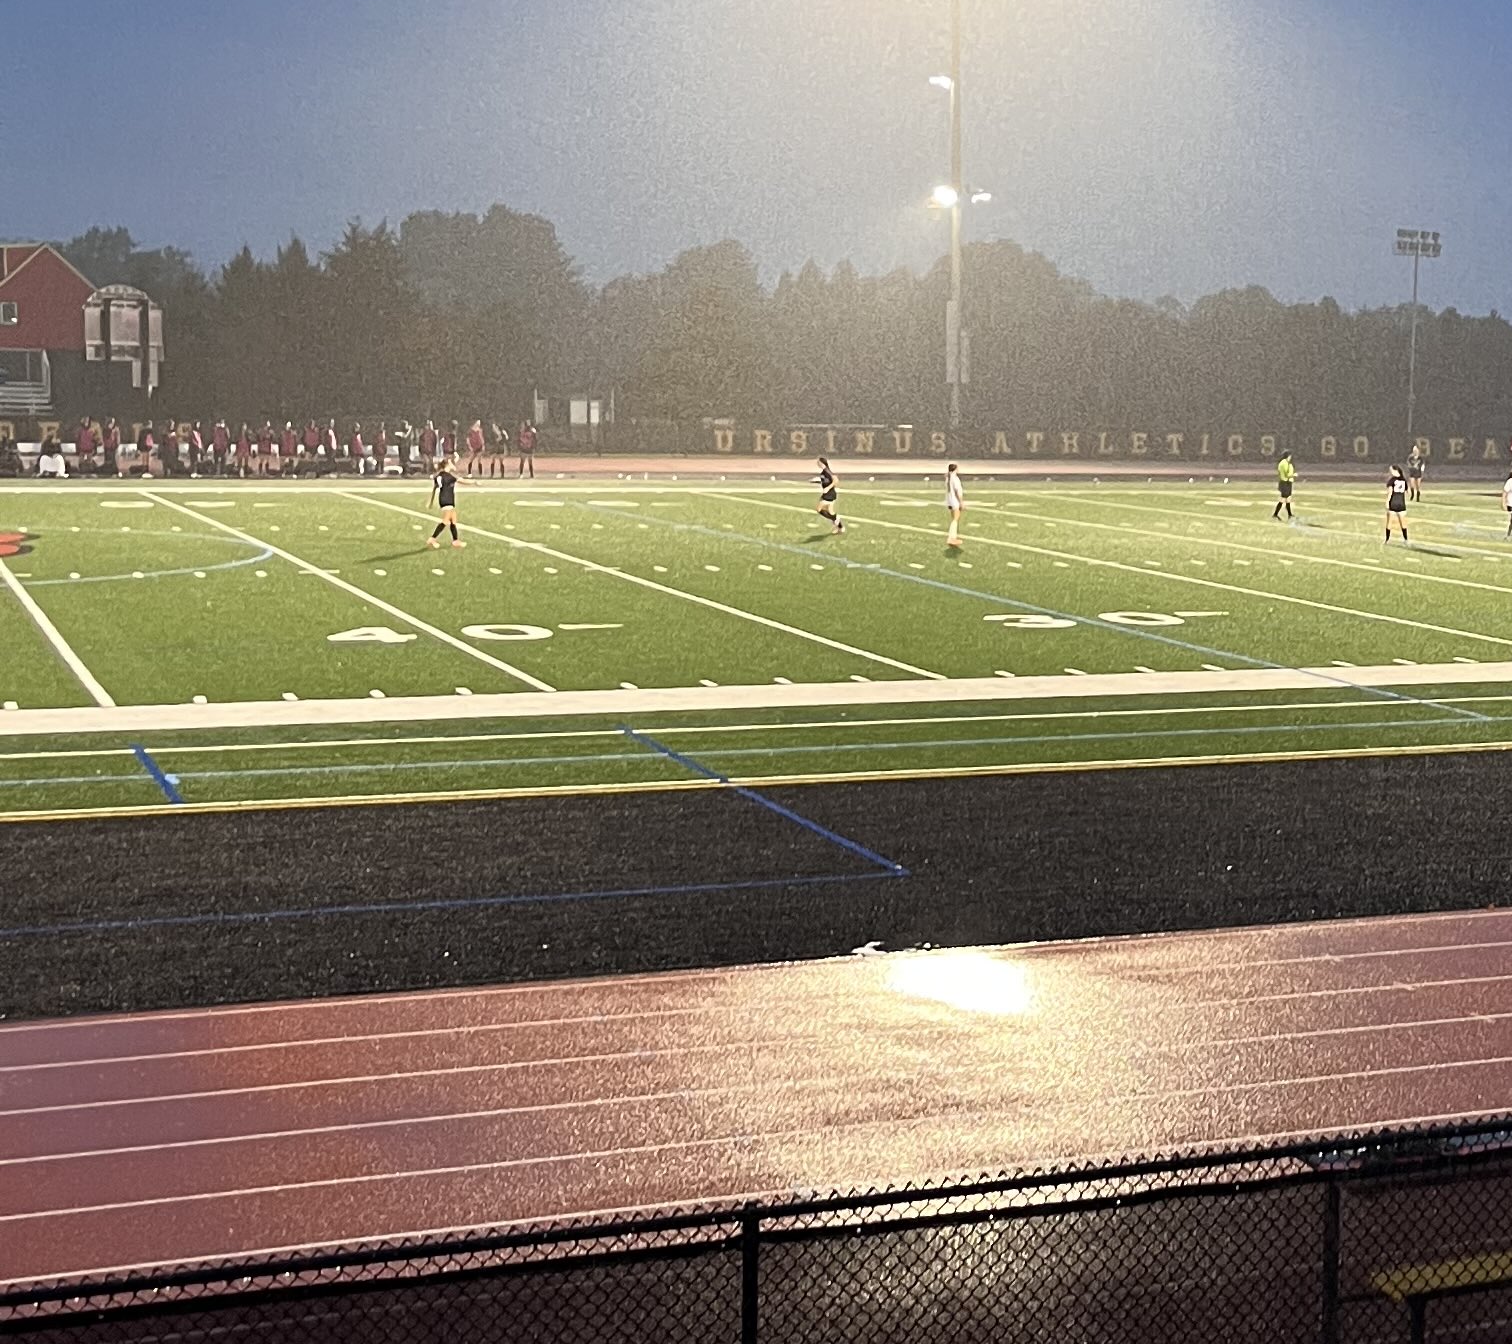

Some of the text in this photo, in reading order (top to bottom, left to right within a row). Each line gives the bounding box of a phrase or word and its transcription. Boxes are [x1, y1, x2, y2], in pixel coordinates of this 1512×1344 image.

[714, 429, 946, 453] URSINUS
[991, 431, 1276, 455] ATHLETICS
[1320, 435, 1369, 456] GO
[982, 610, 1186, 629] 30
[326, 624, 554, 643] 40
